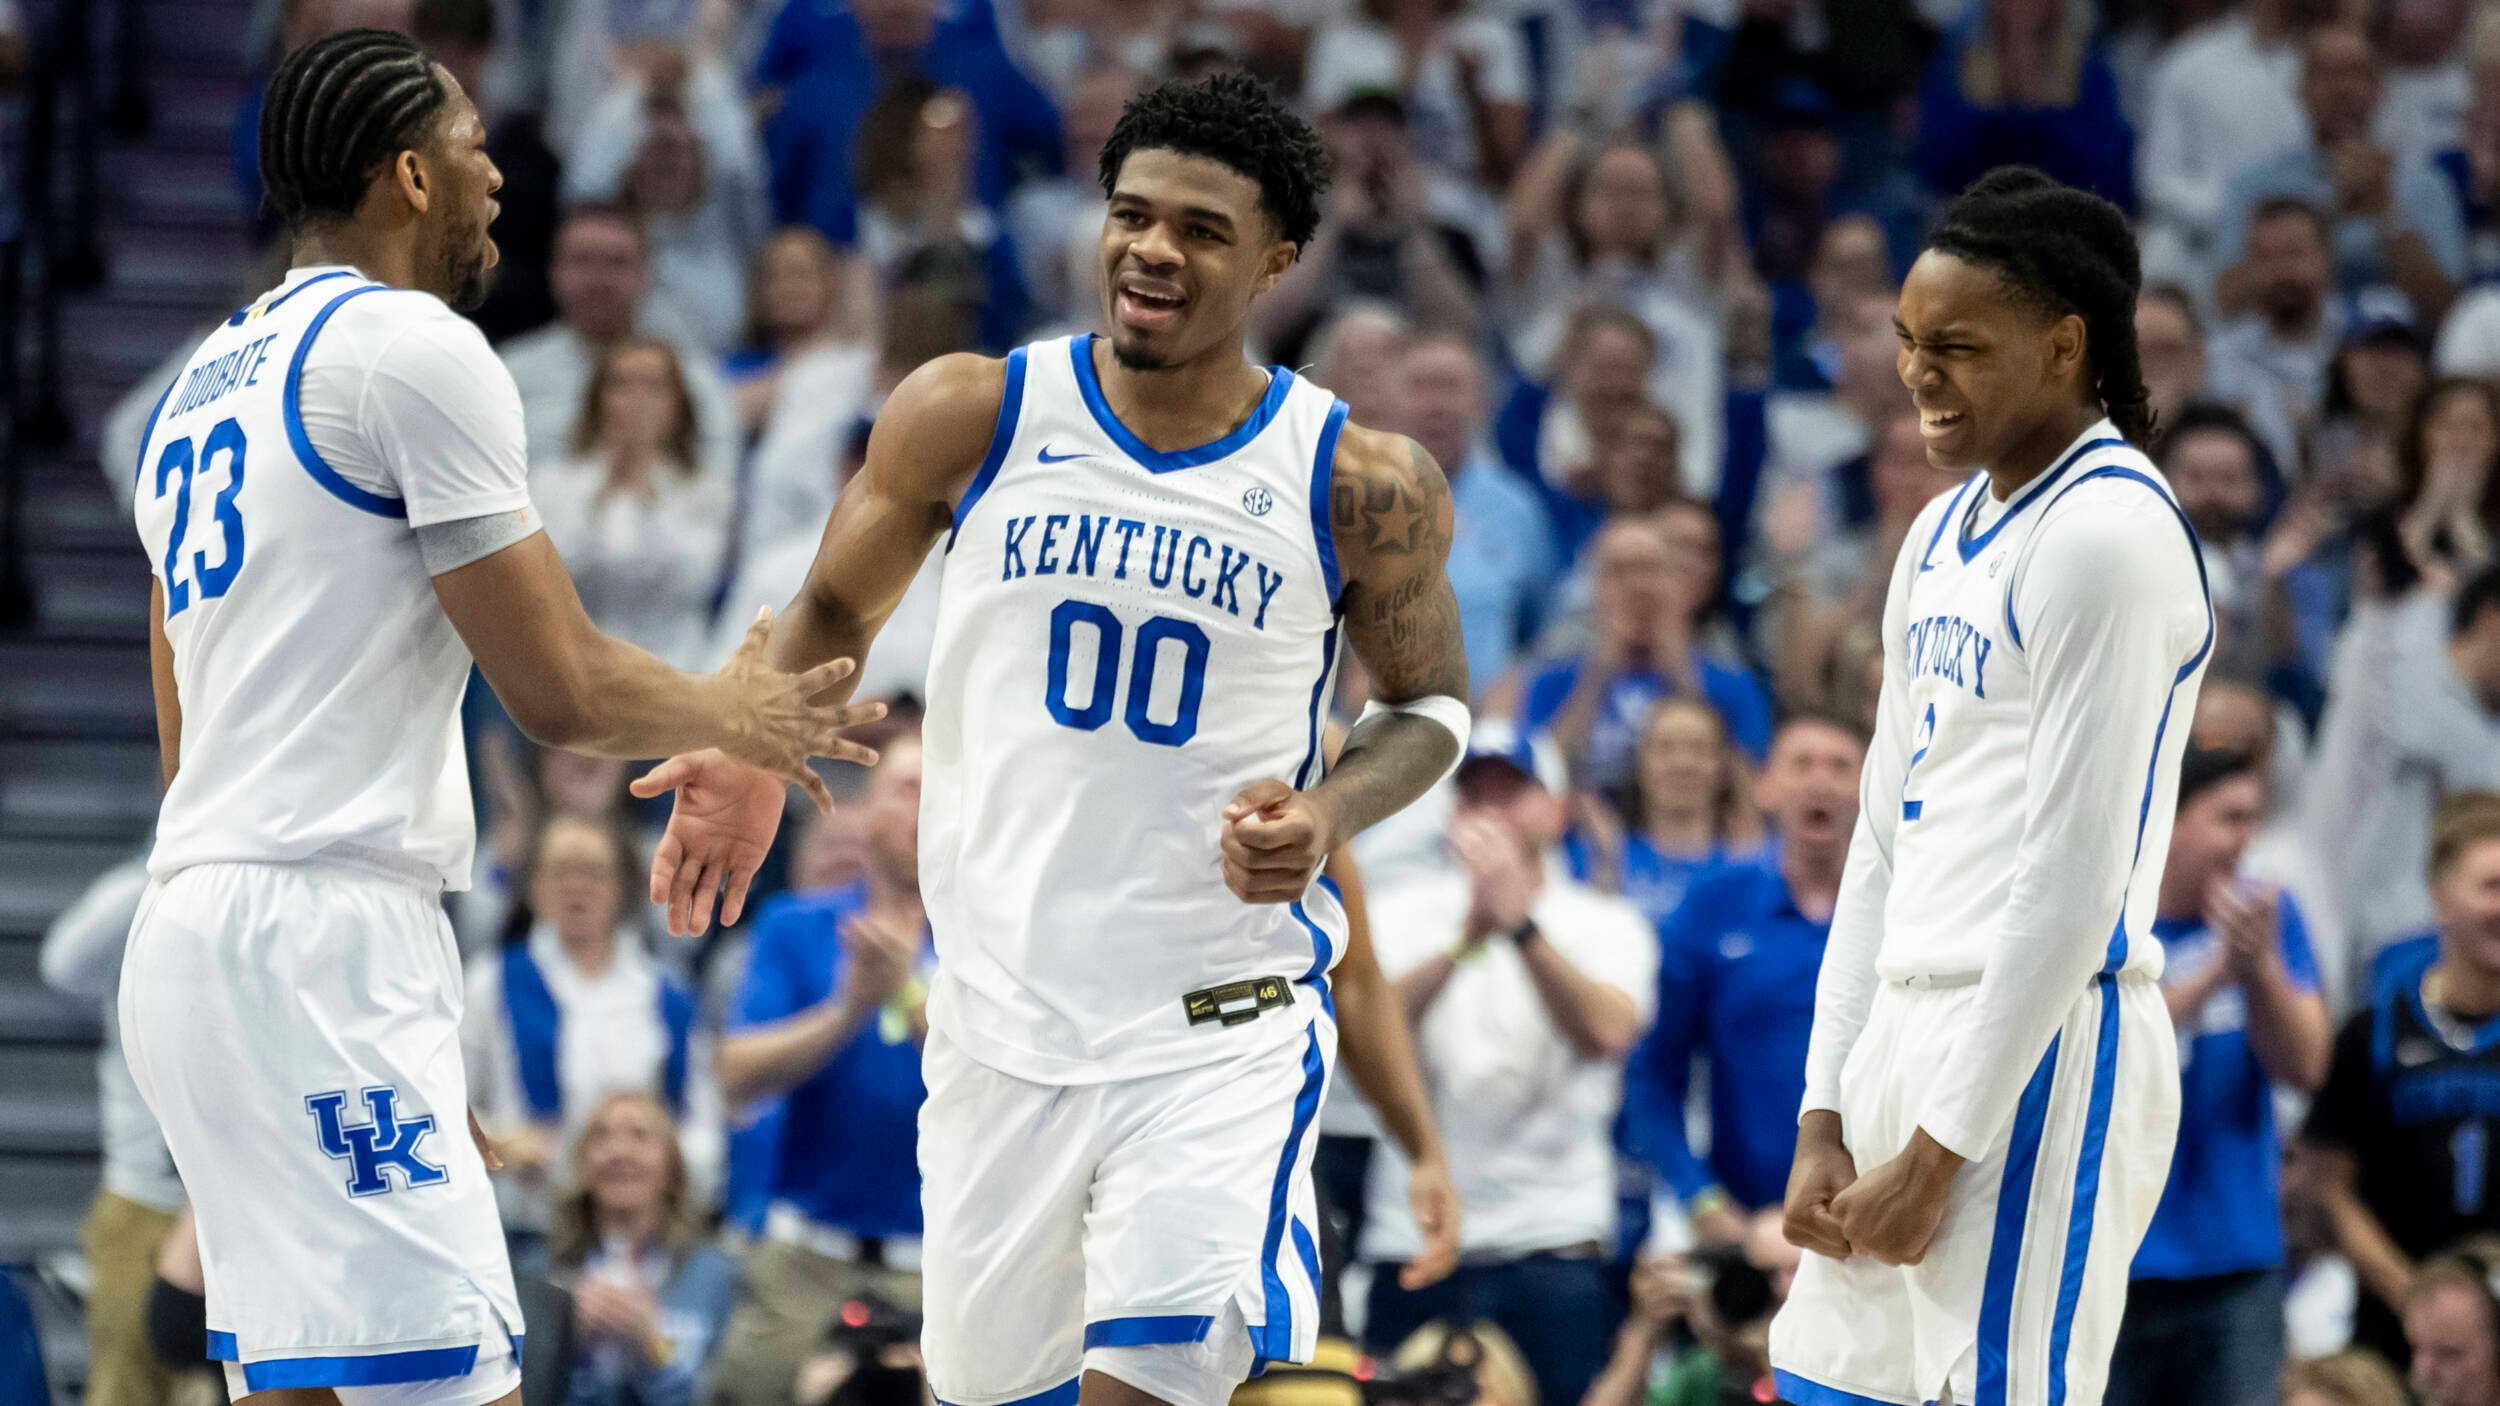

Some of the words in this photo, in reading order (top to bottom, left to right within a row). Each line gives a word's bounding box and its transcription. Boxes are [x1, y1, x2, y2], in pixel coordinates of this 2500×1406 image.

[168, 332, 278, 418] DIOUBATE
[155, 417, 247, 622] 23
[1244, 489, 1271, 514] SEC
[1002, 514, 1284, 631] KENTUCKY
[1045, 599, 1211, 748] 00
[1905, 616, 1991, 699] ENTUCKY
[1902, 702, 1936, 822] 2
[1259, 984, 1279, 1001] 46
[304, 1084, 450, 1199] UK
